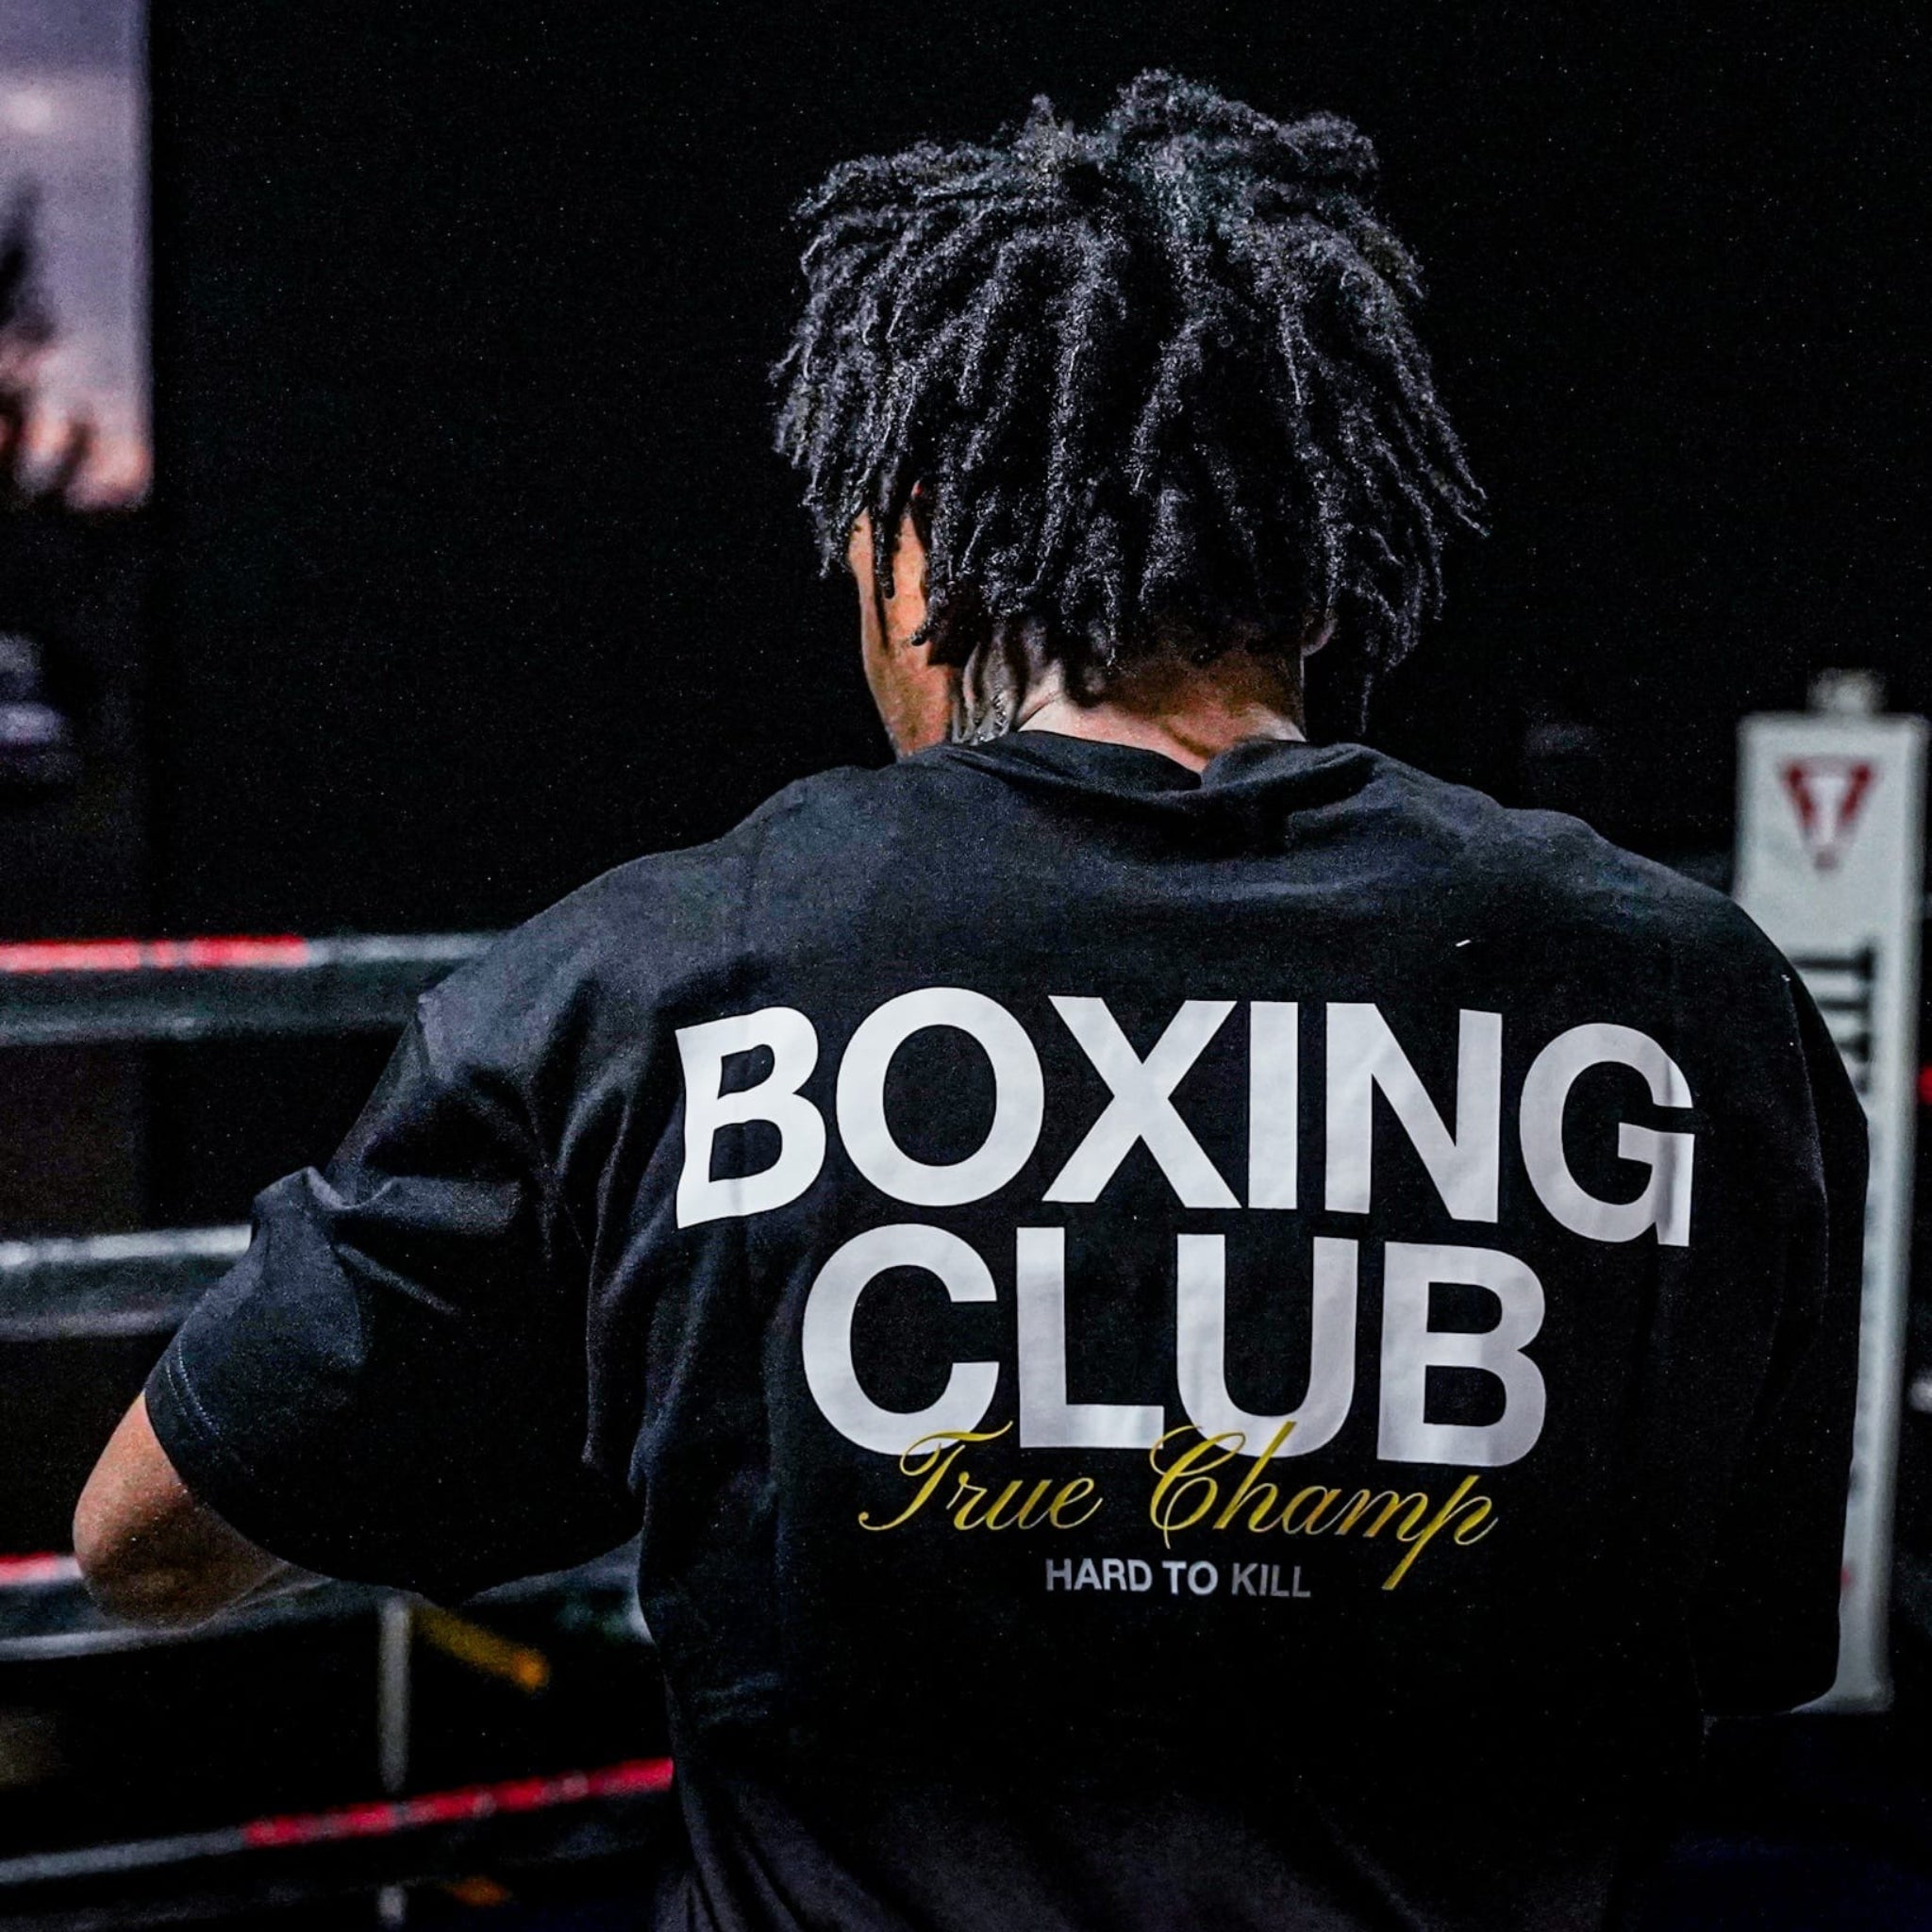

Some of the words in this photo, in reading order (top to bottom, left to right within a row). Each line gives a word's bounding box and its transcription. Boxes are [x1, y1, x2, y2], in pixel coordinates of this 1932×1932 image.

[675, 986, 1696, 1248] BOXING
[801, 1223, 1547, 1469] CLUB
[858, 1420, 1104, 1531] True
[1149, 1420, 1500, 1591] Champ
[1045, 1557, 1153, 1591] HARD
[1161, 1559, 1220, 1595] TO
[1231, 1562, 1312, 1598] KILL
